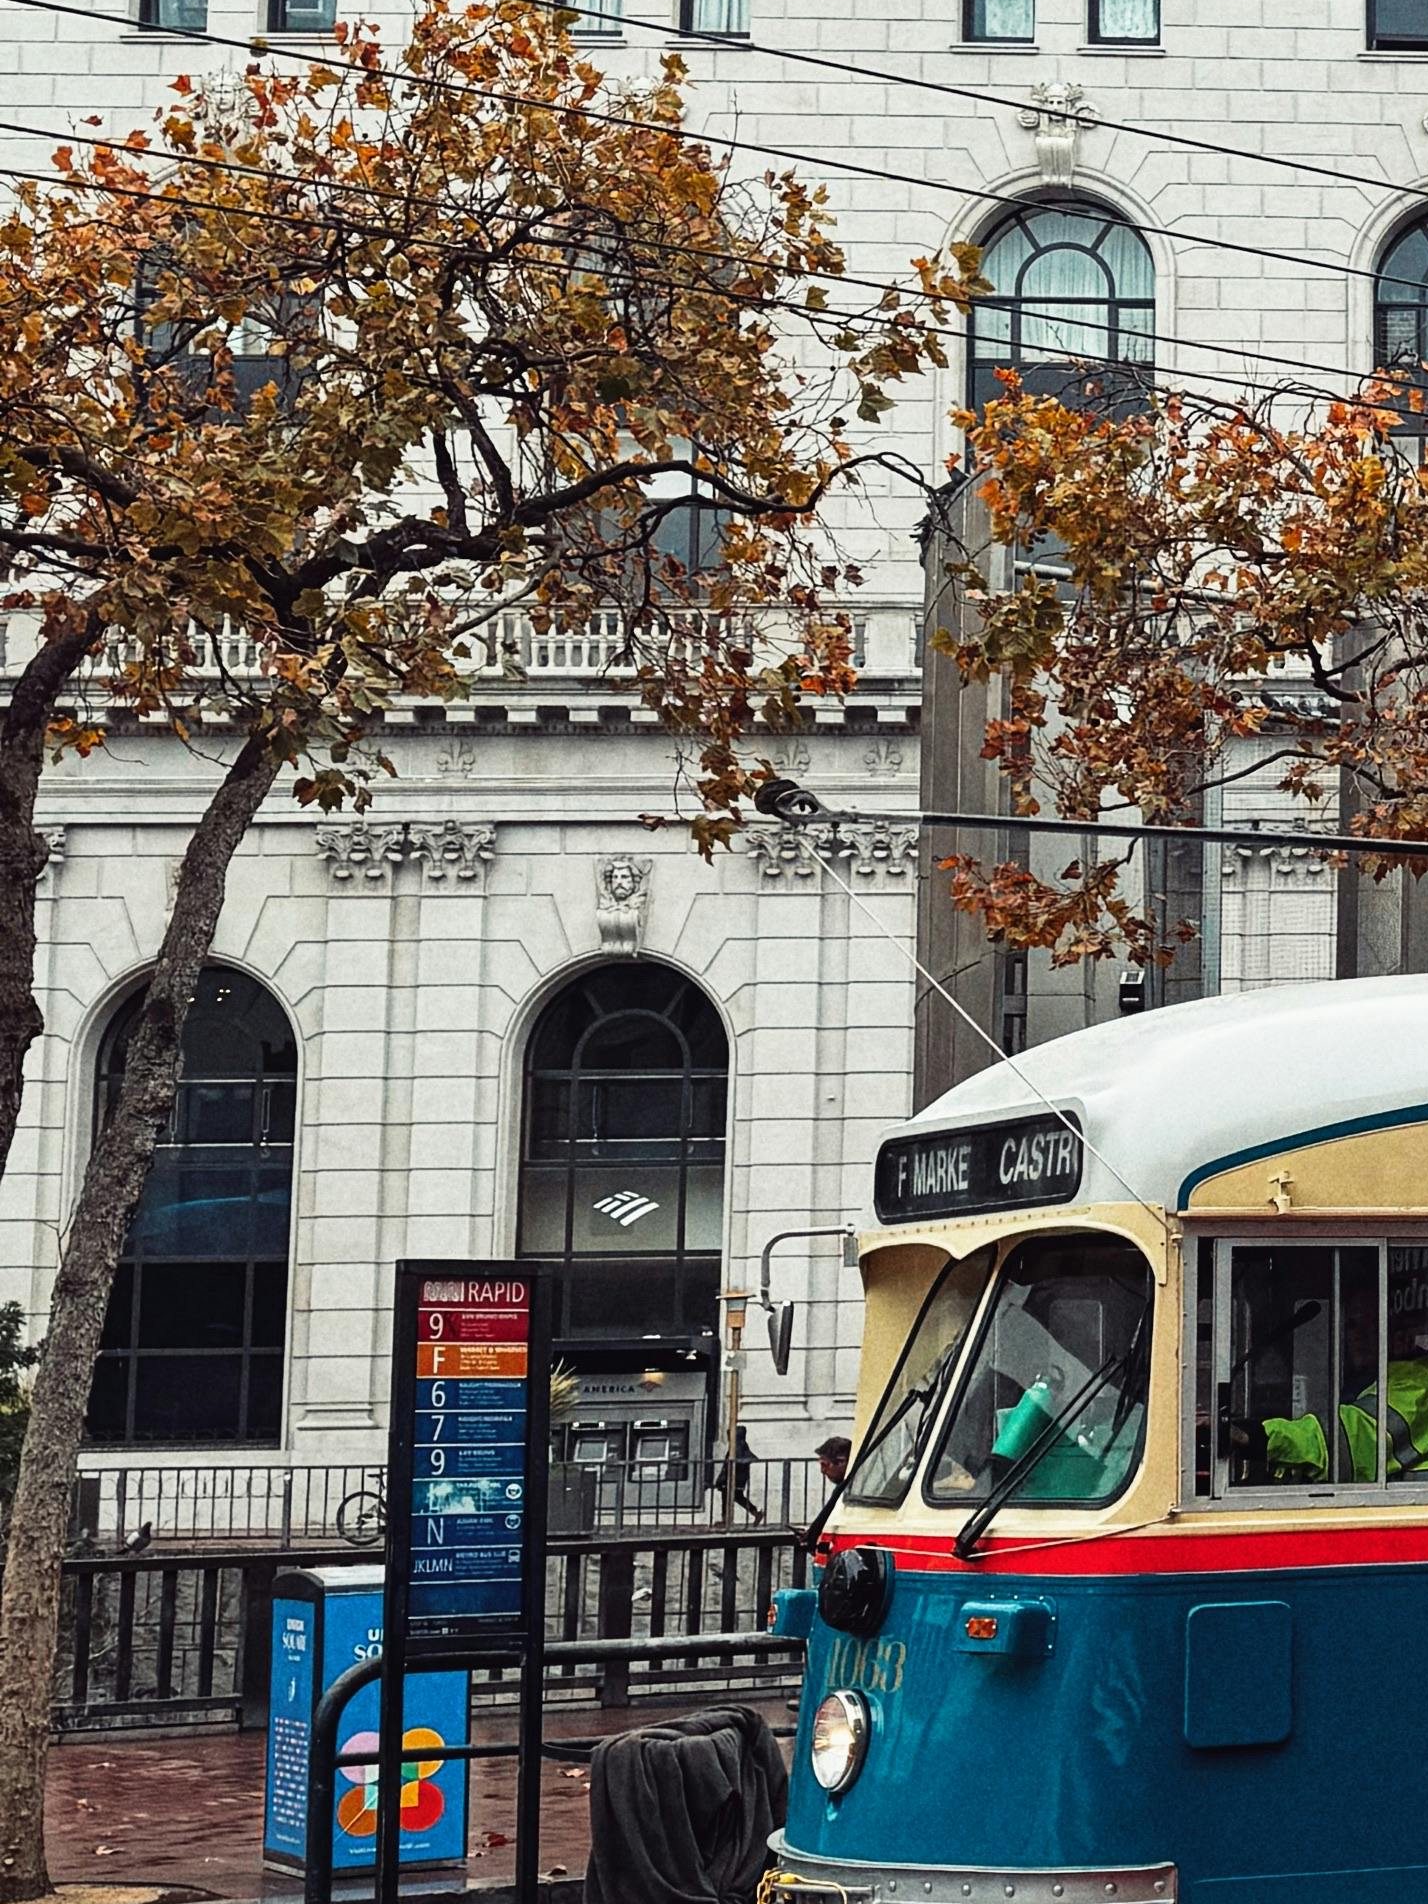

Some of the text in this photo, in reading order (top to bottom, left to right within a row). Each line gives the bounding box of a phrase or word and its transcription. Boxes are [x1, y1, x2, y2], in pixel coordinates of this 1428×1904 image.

[897, 1155, 908, 1198] F
[468, 1282, 525, 1303] RAPID
[433, 1347, 446, 1374] F
[431, 1381, 446, 1408] 6
[583, 1384, 635, 1394] AMERICA
[431, 1415, 445, 1442] 7
[430, 1449, 446, 1476] 9
[427, 1517, 444, 1545] N
